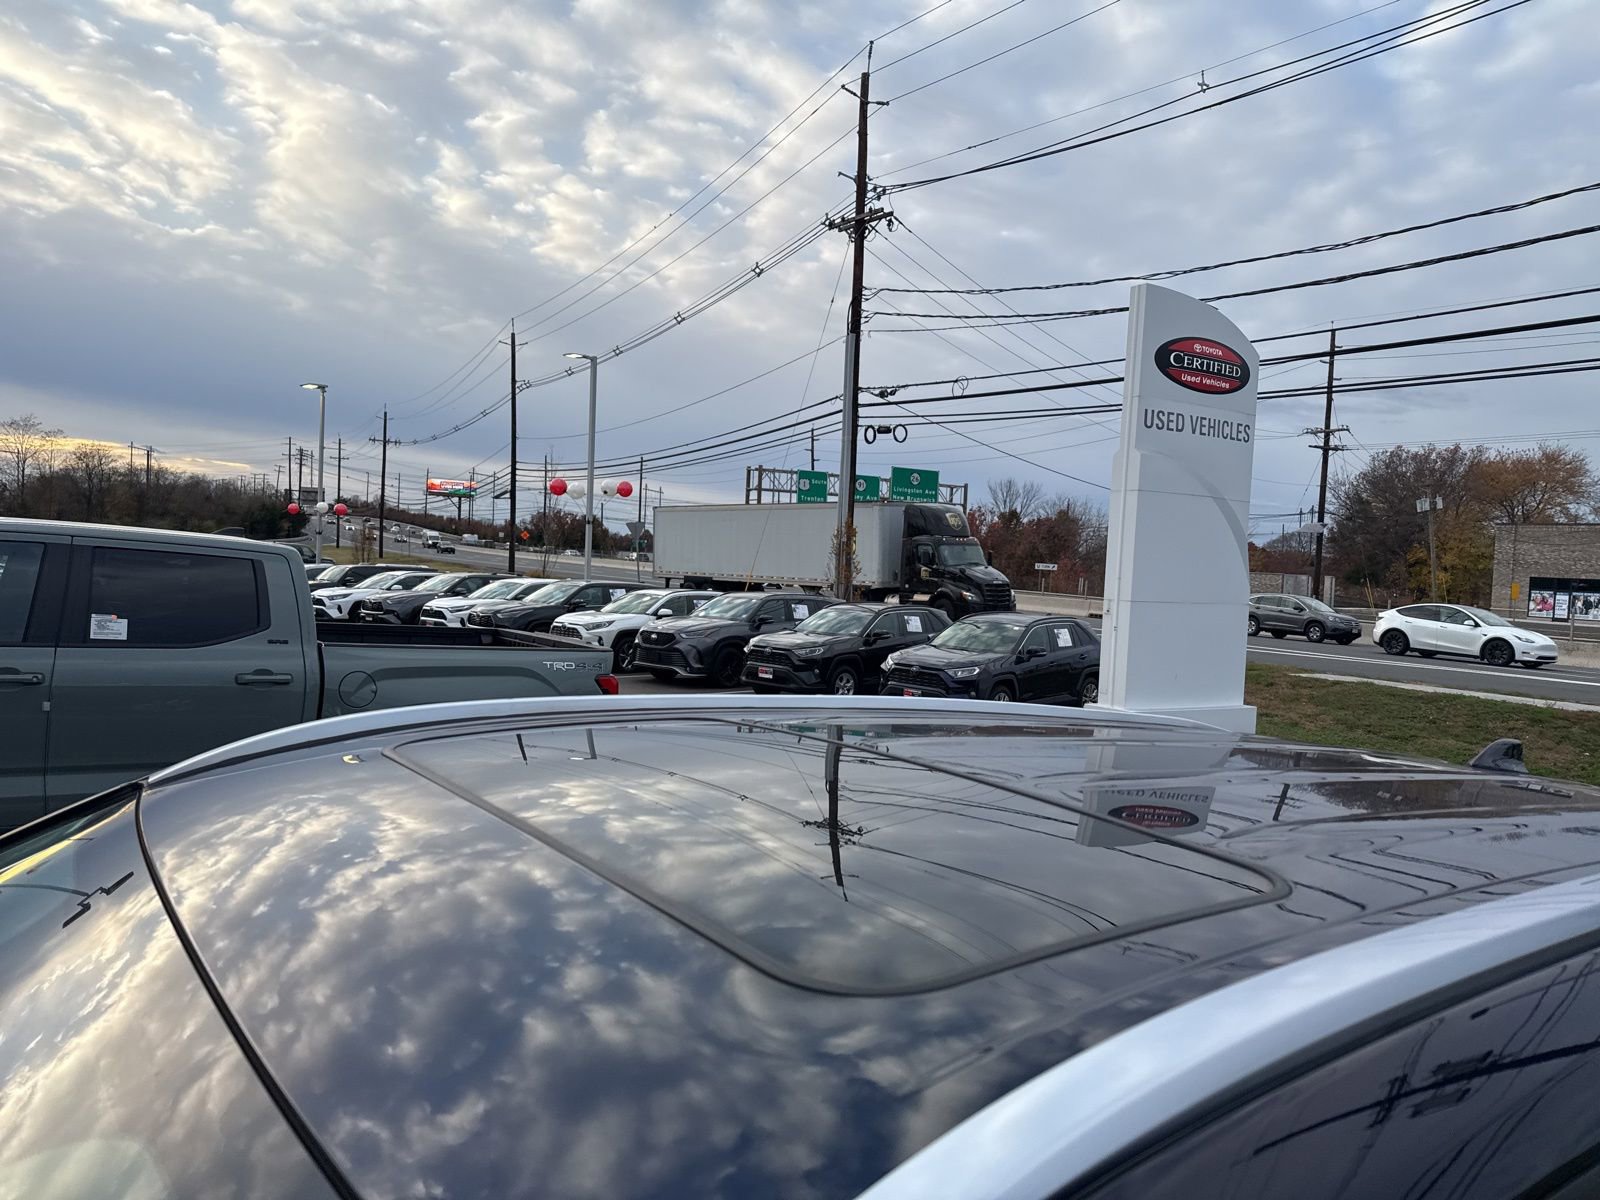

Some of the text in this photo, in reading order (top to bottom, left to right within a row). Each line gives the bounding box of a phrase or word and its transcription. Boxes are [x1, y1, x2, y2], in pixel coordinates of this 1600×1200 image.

[1201, 345, 1223, 356] TOYOTA
[1181, 373, 1230, 389] Used Vehicles
[1144, 408, 1251, 443] USED VEHICLES
[893, 486, 923, 495] Livingston
[801, 495, 825, 503] Trenton
[542, 661, 576, 672] TRD
